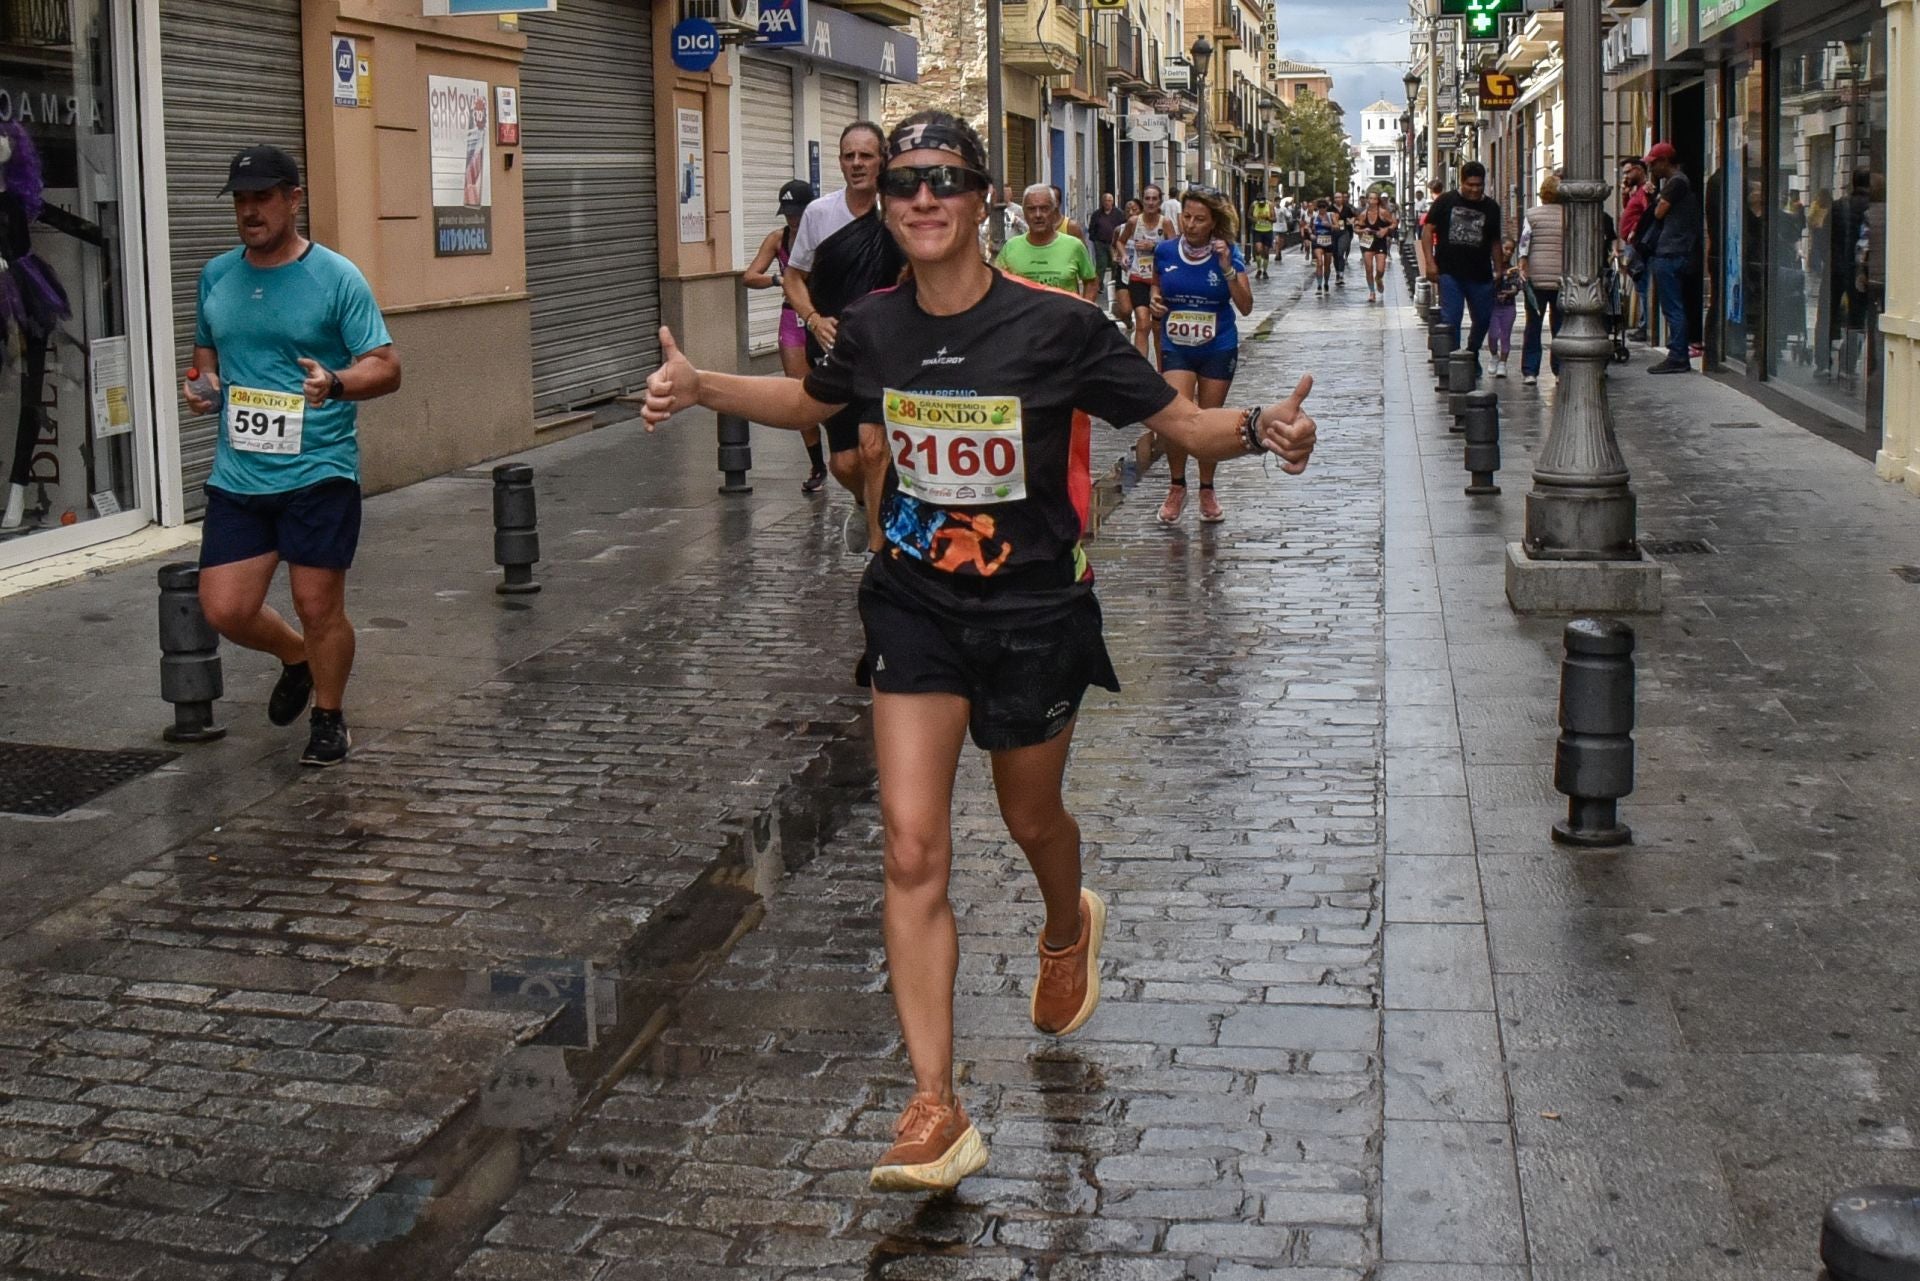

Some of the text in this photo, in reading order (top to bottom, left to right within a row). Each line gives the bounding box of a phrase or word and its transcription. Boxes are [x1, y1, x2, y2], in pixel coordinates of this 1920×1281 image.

[757, 8, 797, 33] AXA
[677, 34, 714, 50] DIGI
[812, 20, 832, 58] AXA
[1267, 3, 1276, 80] PIONONOS
[880, 41, 896, 75] AXA
[1140, 264, 1152, 273] 21
[1168, 322, 1212, 339] 2016
[898, 400, 916, 419] 38
[917, 407, 987, 424] FONDO
[919, 401, 944, 410] GRAN
[945, 402, 979, 411] PREMIO
[234, 410, 286, 438] 591
[892, 430, 1016, 477] 2160
